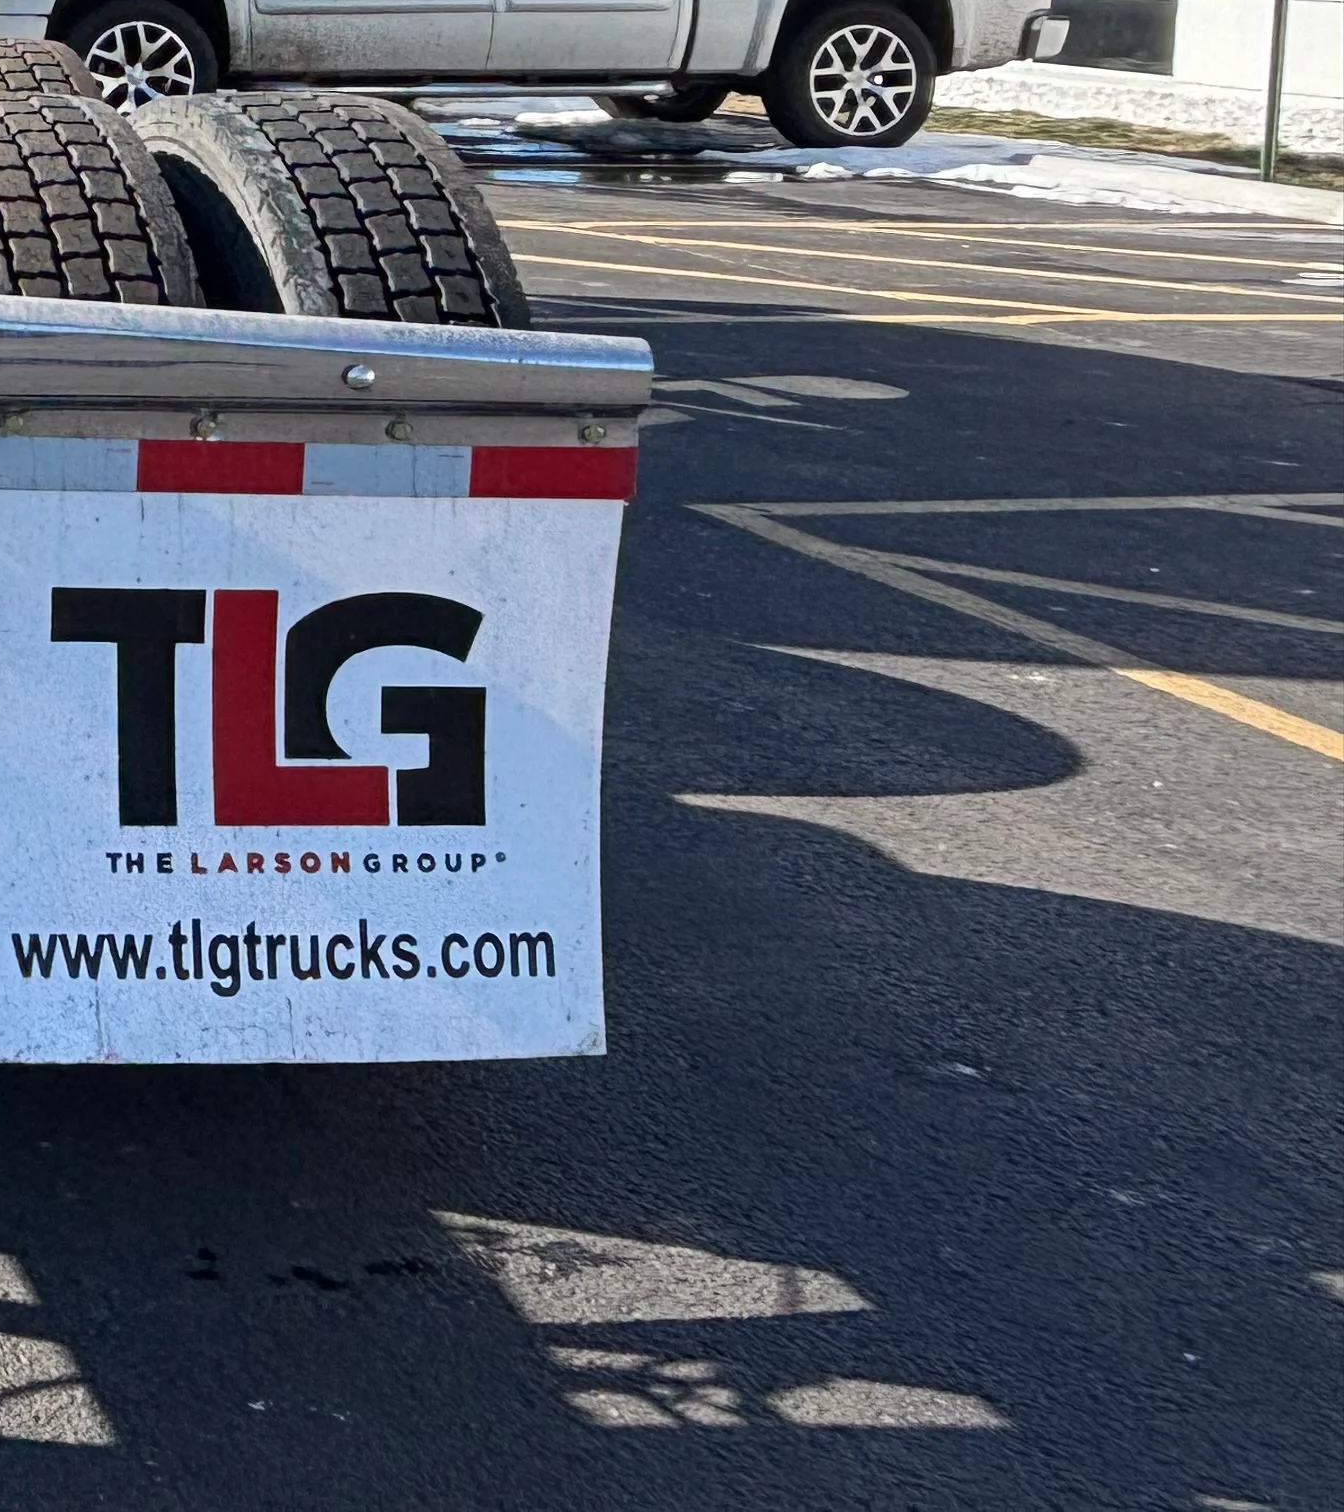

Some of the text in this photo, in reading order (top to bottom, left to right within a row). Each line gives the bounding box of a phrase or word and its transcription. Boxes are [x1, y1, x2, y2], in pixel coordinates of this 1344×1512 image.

[51, 587, 486, 826] TLG
[106, 852, 173, 874] THE
[191, 852, 351, 874] LARSON
[11, 919, 556, 997] www.tlgtrucks.com
